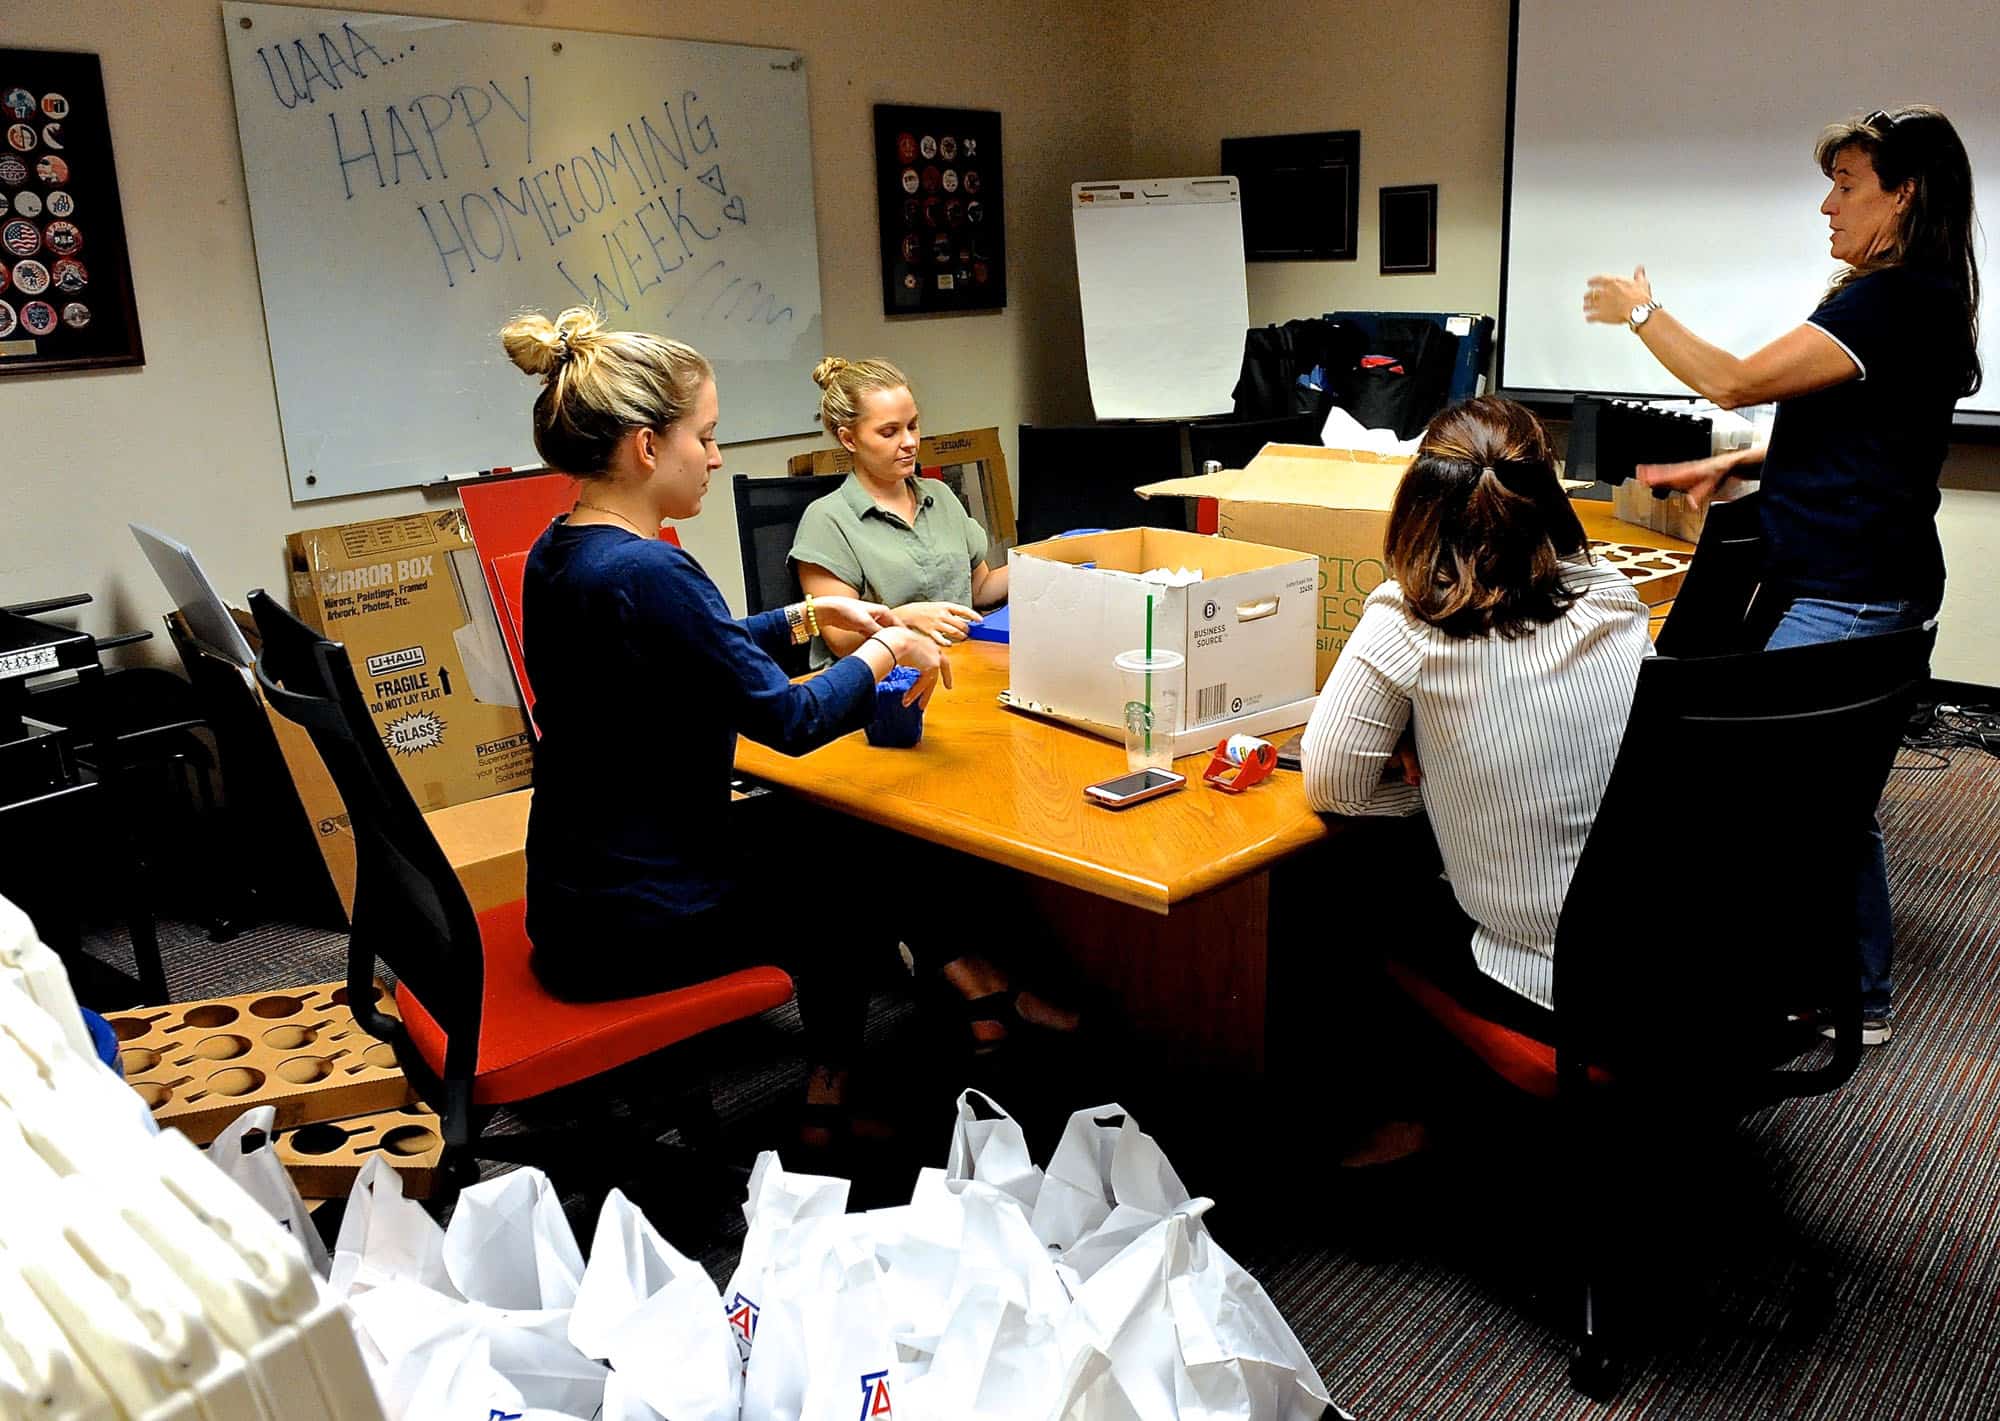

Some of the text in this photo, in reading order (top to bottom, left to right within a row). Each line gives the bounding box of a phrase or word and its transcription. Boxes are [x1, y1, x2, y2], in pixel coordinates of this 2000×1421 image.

[328, 76, 534, 199] HAPPY
[417, 90, 719, 288] HOMECOMING
[397, 556, 434, 582] BOX
[324, 581, 428, 609] Mirrors, Paintings, Framed
[327, 596, 411, 621] Artwork, Photos, Etc.
[1194, 624, 1226, 639] BUSINESS
[1196, 634, 1223, 648] SOURCE
[370, 650, 422, 669] U-HAUL
[375, 672, 430, 699] FRAGILE
[370, 688, 442, 714] DO NOT LAY FLAT
[395, 723, 435, 744] GLASS
[476, 739, 516, 757] Picture
